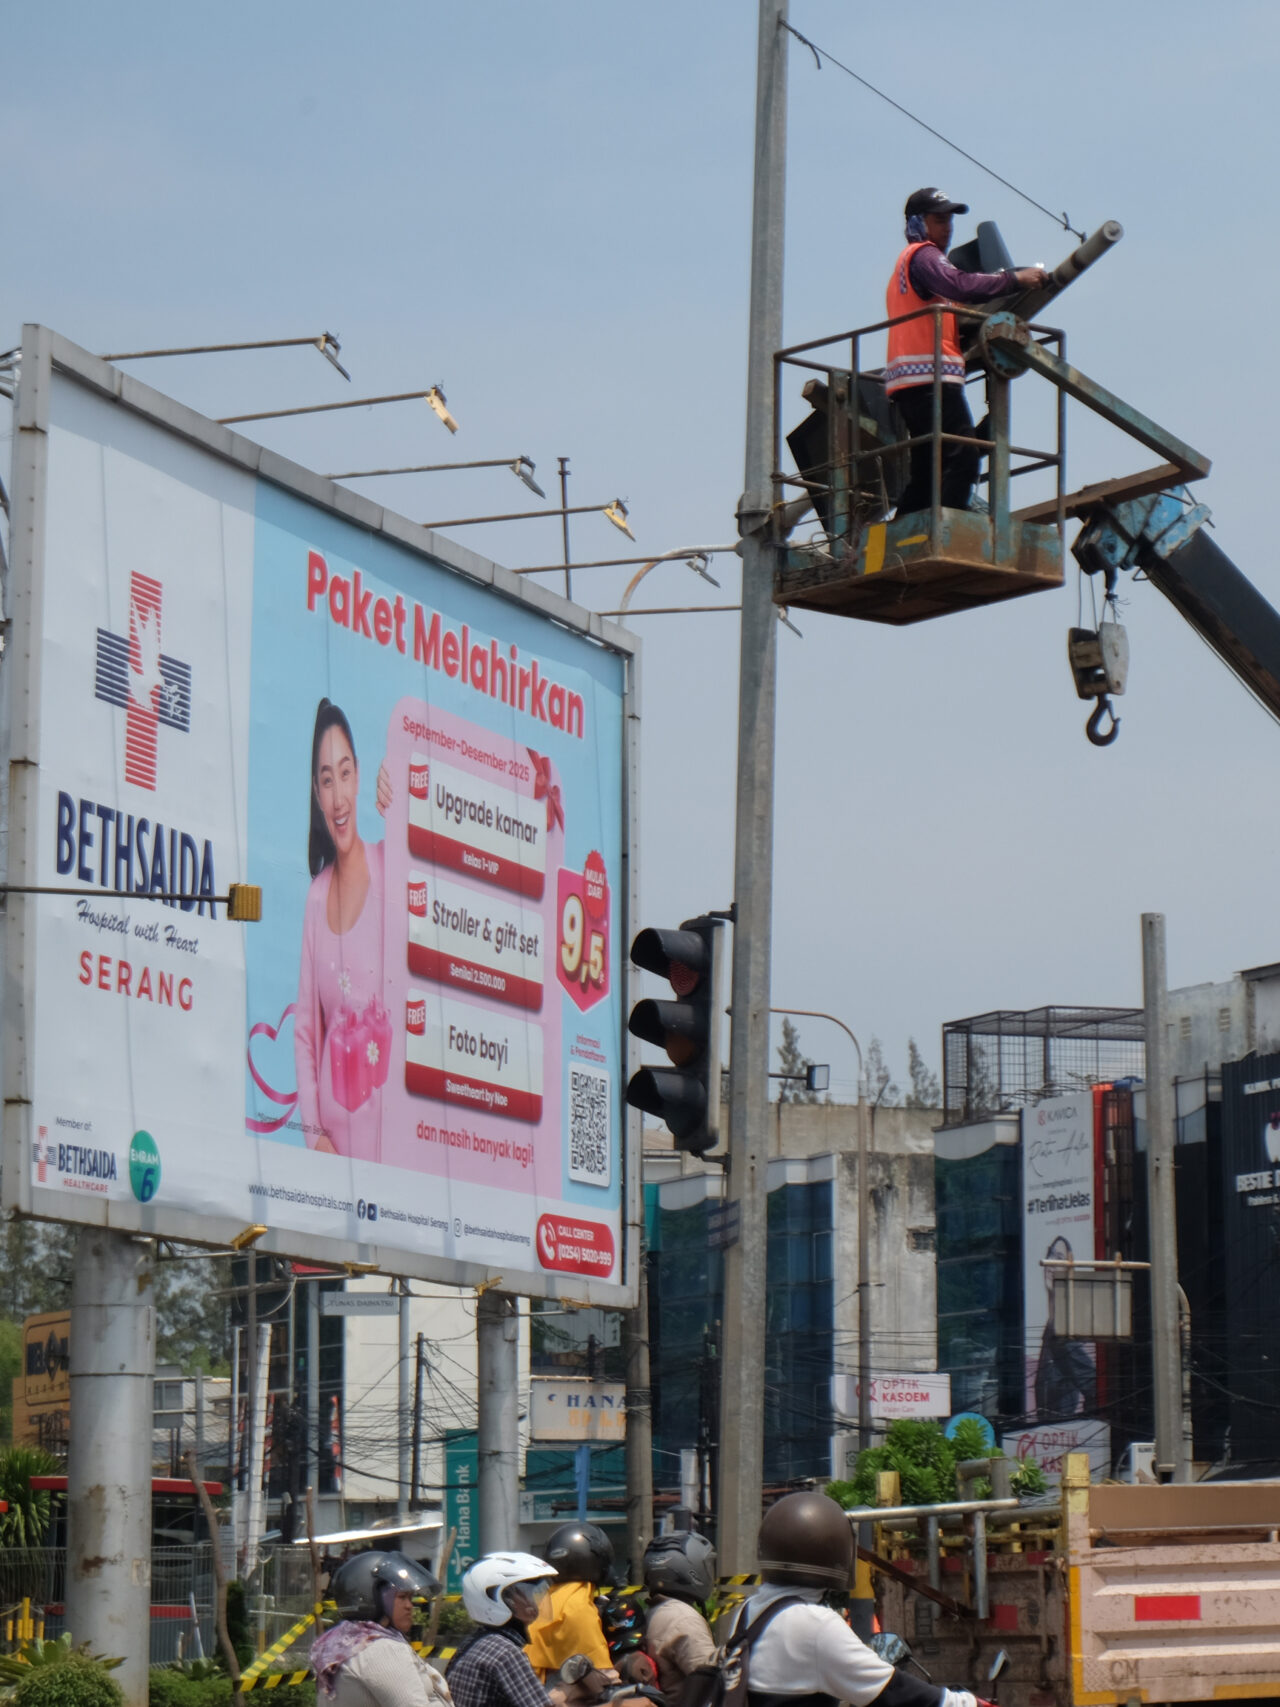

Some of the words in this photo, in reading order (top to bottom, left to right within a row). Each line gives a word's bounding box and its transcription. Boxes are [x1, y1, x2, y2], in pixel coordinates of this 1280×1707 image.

[306, 549, 407, 655] Paket
[413, 601, 585, 740] Melahirkan
[402, 715, 508, 773] September-Desember
[508, 760, 530, 783] 2025
[410, 770, 429, 790] FREE
[436, 783, 494, 829] Upgrade
[495, 806, 538, 845] kamar
[56, 790, 217, 921] BETHSAIDA
[462, 849, 482, 870] kelas
[586, 868, 605, 890] MULAI
[408, 886, 427, 907] FREE
[587, 883, 603, 900] DARI
[76, 899, 131, 935] Hospital
[134, 919, 160, 944] with
[164, 924, 200, 955] Heart
[432, 899, 481, 938] Stroller
[482, 917, 493, 942] &
[495, 921, 518, 955] gift
[519, 933, 540, 957] set
[78, 950, 194, 1012] SERANG
[449, 962, 474, 983] Senilai
[473, 970, 506, 992] 2.500.000
[407, 1005, 426, 1026] FREE
[449, 1023, 477, 1056] Foto
[479, 1033, 509, 1071] bayi
[445, 1078, 486, 1103] Sweetheart
[485, 1087, 494, 1110] by
[55, 1116, 84, 1130] Member
[416, 1119, 438, 1143] dan
[439, 1127, 471, 1151] masih
[472, 1131, 512, 1162] banyak
[512, 1141, 535, 1169] lagi!
[57, 1142, 118, 1181] BETHSAIDA
[63, 1177, 110, 1193] HEALTHCARE
[141, 1167, 155, 1203] 6
[1236, 1170, 1274, 1192] BESTIE
[248, 1183, 354, 1213] www.bethsaidahospitals.com
[1027, 1191, 1091, 1215] #TerlihatJelas
[379, 1206, 407, 1222] Bethsaida
[407, 1211, 430, 1227] Hospital
[558, 1224, 573, 1239] CALL
[573, 1228, 595, 1242] CENTER
[557, 1242, 581, 1264] (0254)
[581, 1246, 613, 1266] 5020-999
[882, 1379, 920, 1390] OPTIK
[882, 1392, 931, 1403] KASOEM
[1041, 1430, 1079, 1451] OPTIK
[456, 1506, 471, 1548] Hana
